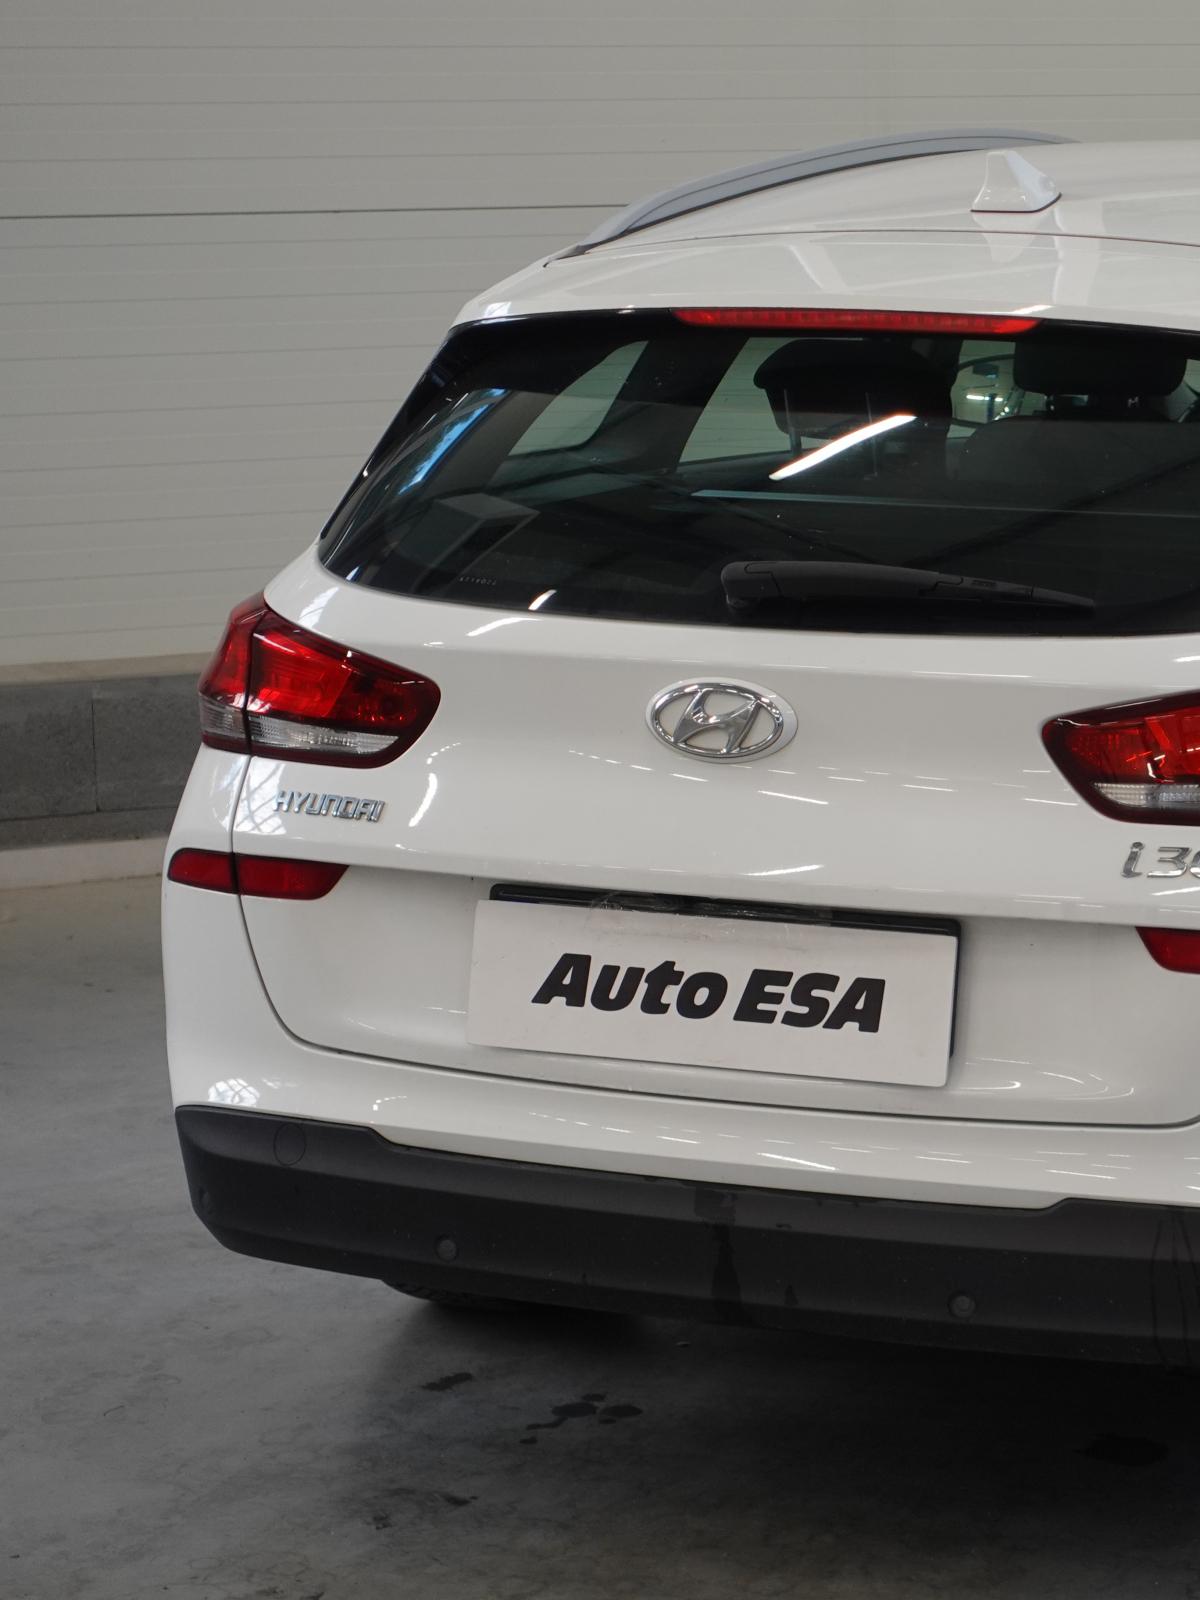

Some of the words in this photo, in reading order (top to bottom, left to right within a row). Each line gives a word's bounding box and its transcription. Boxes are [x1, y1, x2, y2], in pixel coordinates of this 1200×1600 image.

[273, 790, 385, 822] HYUNDAI
[531, 952, 728, 1019] Auto
[733, 968, 886, 1034] ESA
